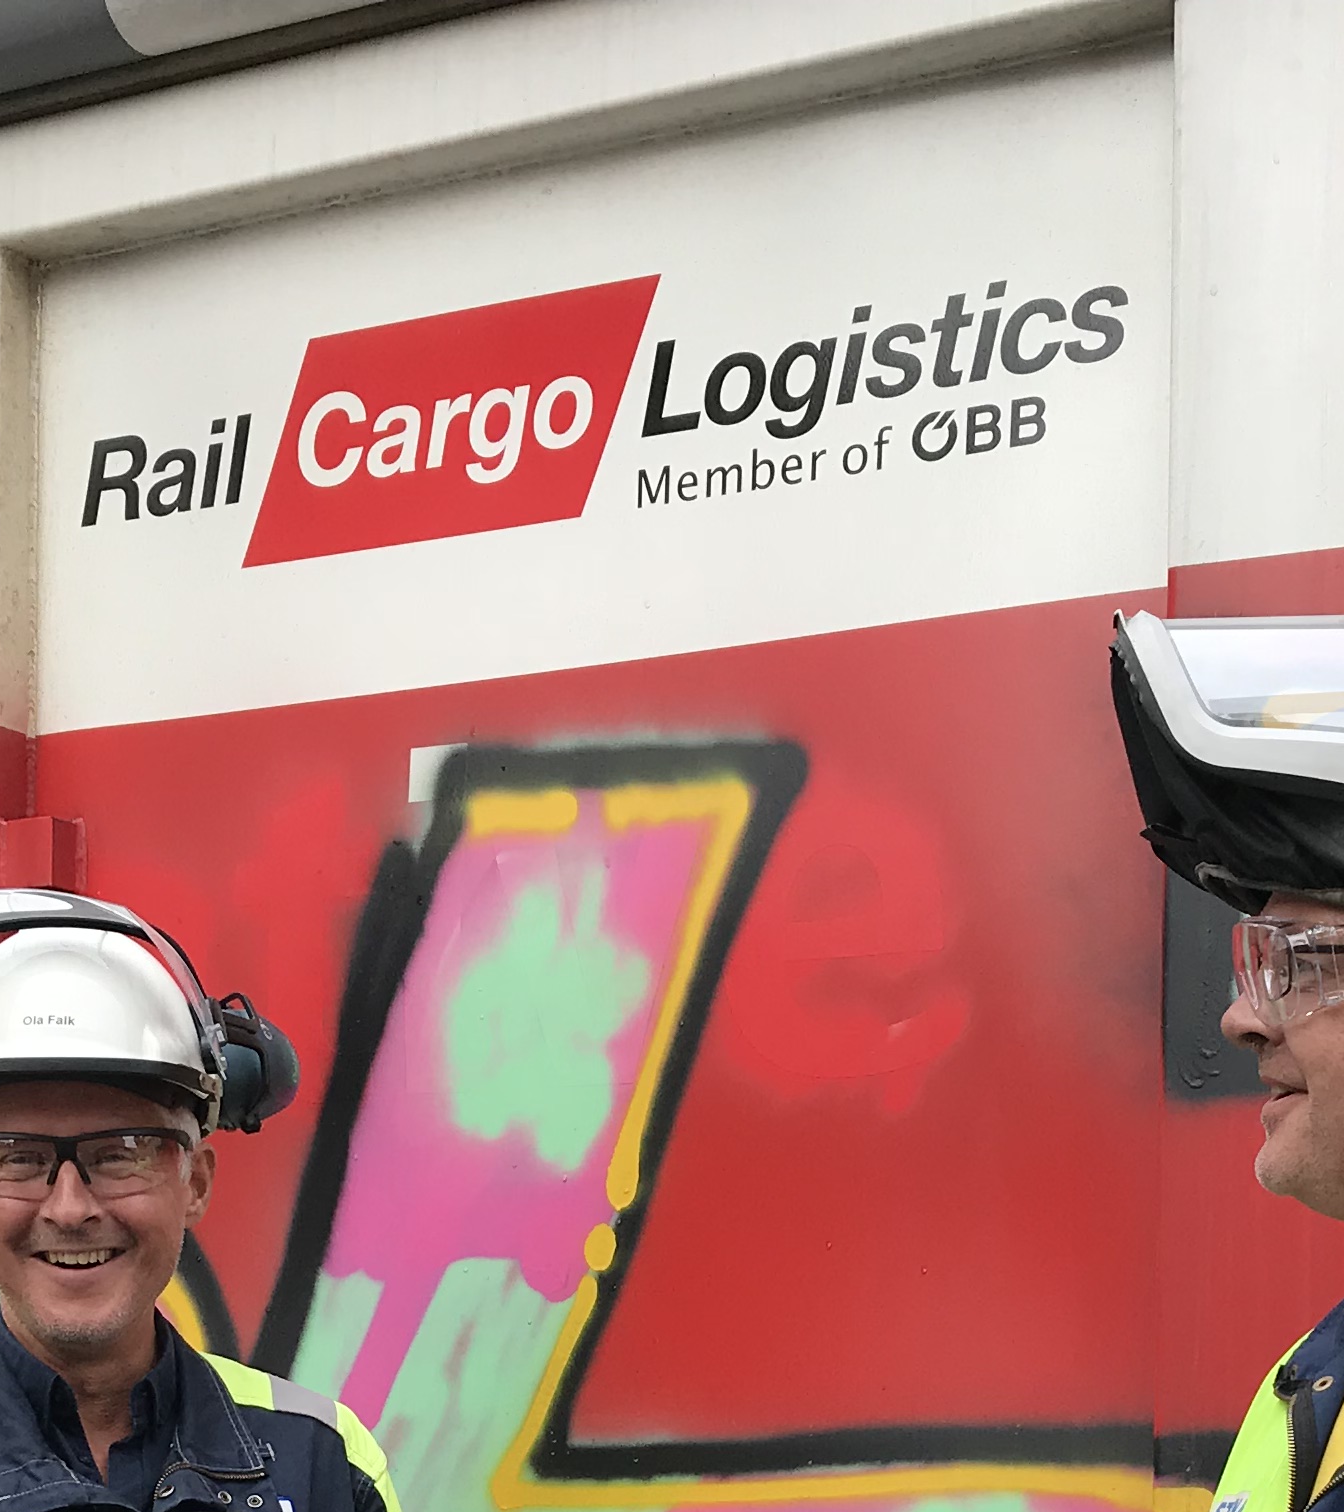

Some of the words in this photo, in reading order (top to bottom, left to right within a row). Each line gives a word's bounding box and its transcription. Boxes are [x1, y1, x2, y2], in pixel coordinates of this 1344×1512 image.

[80, 412, 253, 528] Rail
[295, 374, 596, 491] Cargo
[640, 279, 1130, 443] Logistics
[636, 448, 828, 511] Member
[841, 426, 894, 473] of
[910, 395, 1049, 466] ÖBB
[23, 1016, 43, 1025] Ola
[48, 1015, 75, 1026] Falk
